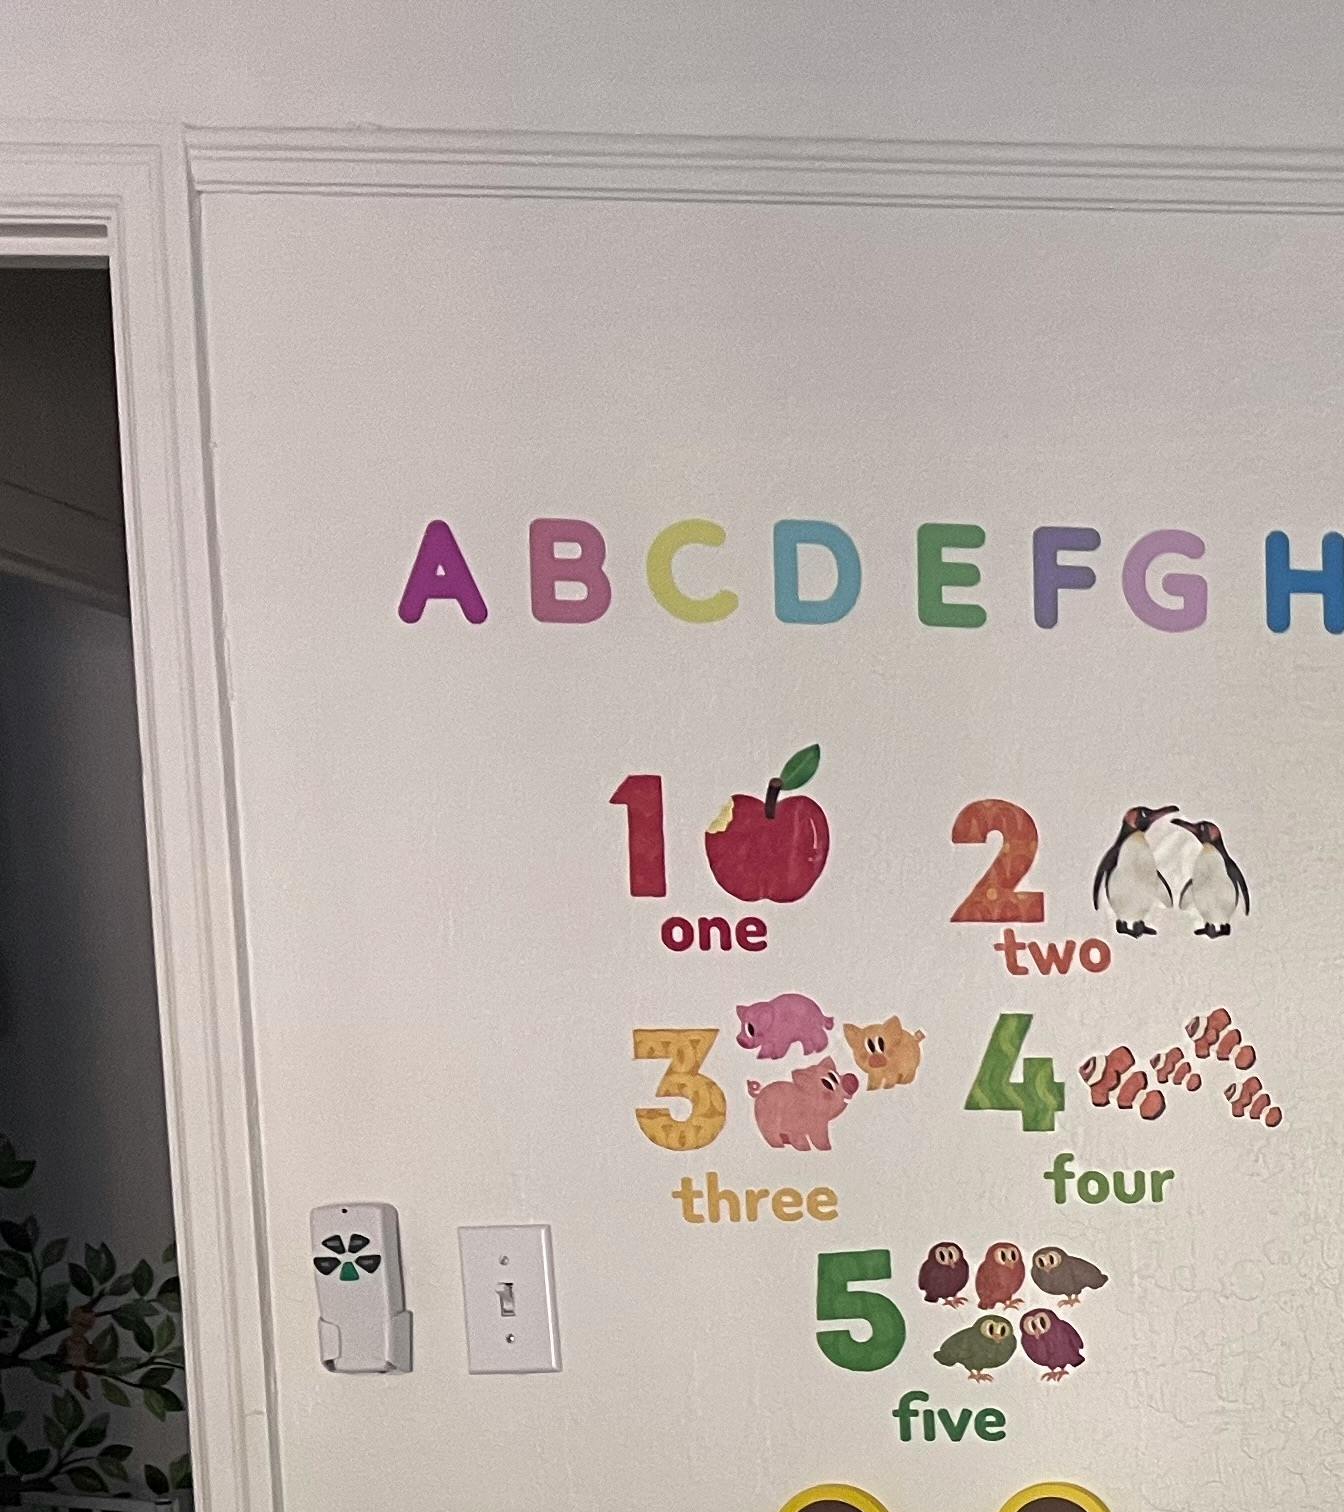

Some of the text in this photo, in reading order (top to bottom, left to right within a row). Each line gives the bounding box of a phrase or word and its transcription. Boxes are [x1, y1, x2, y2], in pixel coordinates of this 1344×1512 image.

[397, 519, 489, 625] A
[529, 517, 612, 624] B
[645, 517, 739, 624] C
[773, 519, 862, 625] D
[917, 522, 988, 628] E
[1033, 526, 1102, 630] F
[1121, 529, 1209, 634] G
[609, 774, 668, 899] 1
[949, 798, 1047, 924] 2
[660, 914, 768, 953] one
[993, 928, 1113, 976] two
[631, 1027, 727, 1152] 3
[964, 1012, 1066, 1133] 4
[672, 1172, 840, 1224] three
[1043, 1153, 1174, 1205] four
[815, 1249, 906, 1372] 5
[891, 1391, 1008, 1442] five
